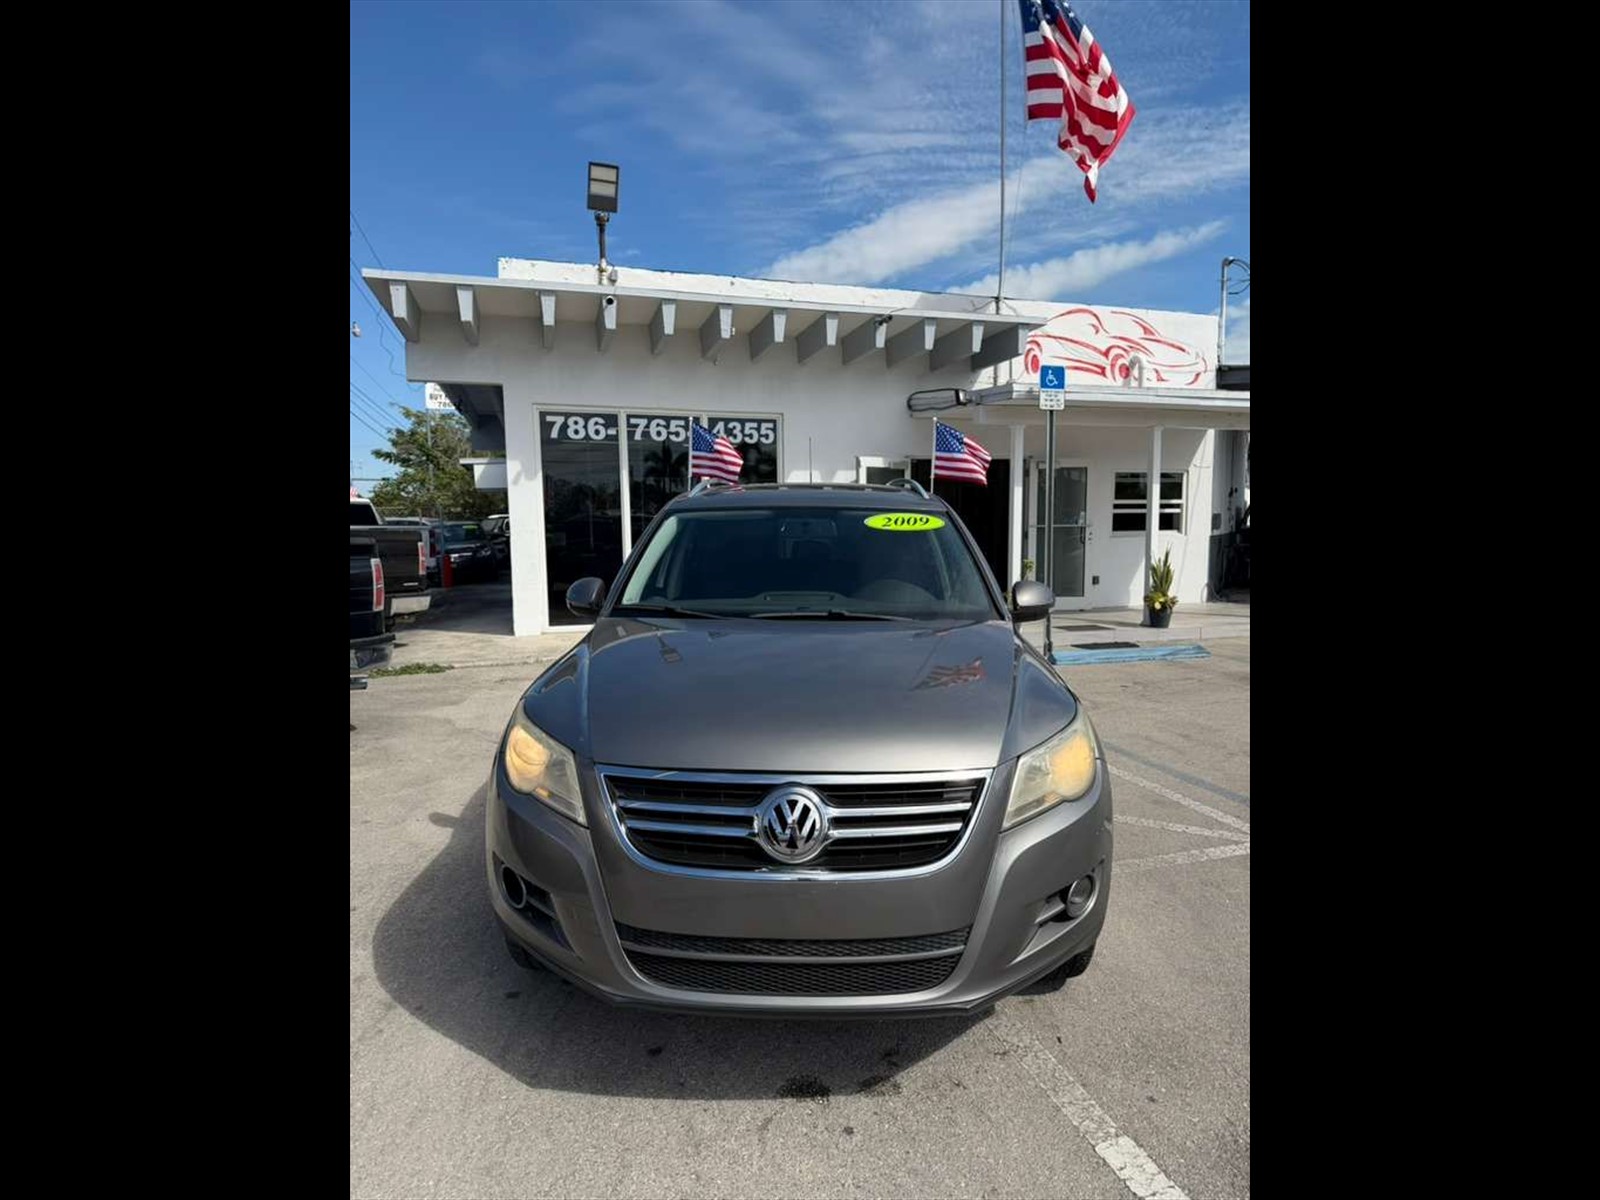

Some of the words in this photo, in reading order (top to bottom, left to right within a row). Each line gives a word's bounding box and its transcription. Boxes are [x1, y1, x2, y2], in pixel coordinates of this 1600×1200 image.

[545, 415, 617, 440] 786-
[629, 418, 690, 442] 765
[712, 421, 775, 444] 4355
[881, 516, 930, 528] 2009
[763, 791, 823, 858] VW
